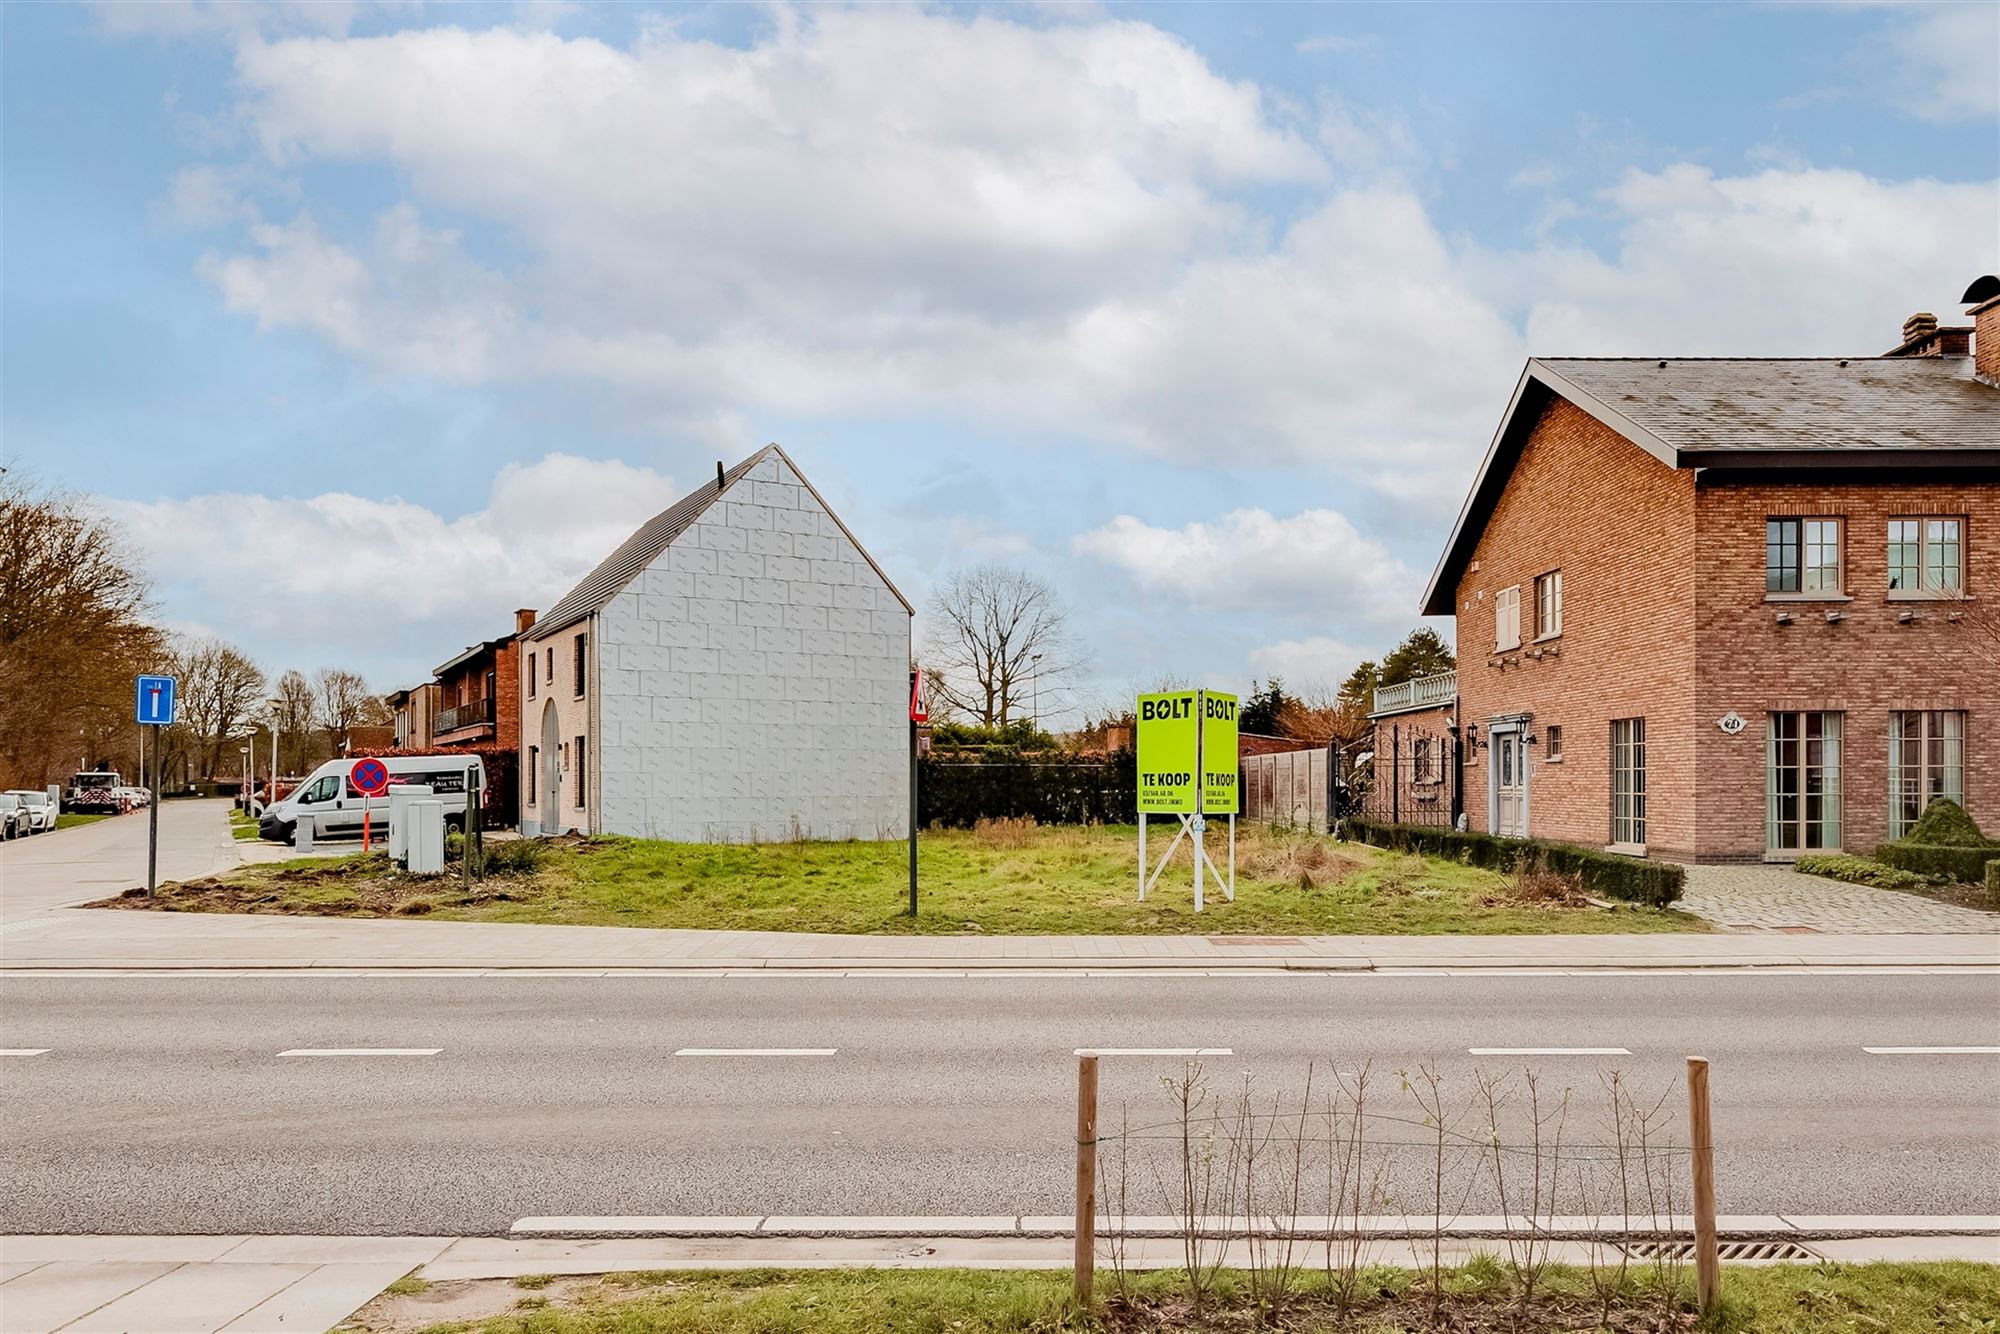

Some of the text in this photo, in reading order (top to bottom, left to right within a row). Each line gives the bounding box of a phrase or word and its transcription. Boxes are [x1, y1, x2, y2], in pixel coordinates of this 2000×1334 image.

[1142, 697, 1192, 721] BOLT
[1206, 697, 1236, 721] BOLT
[1142, 772, 1191, 786] TE KOOP
[1206, 772, 1235, 787] TE KOOP
